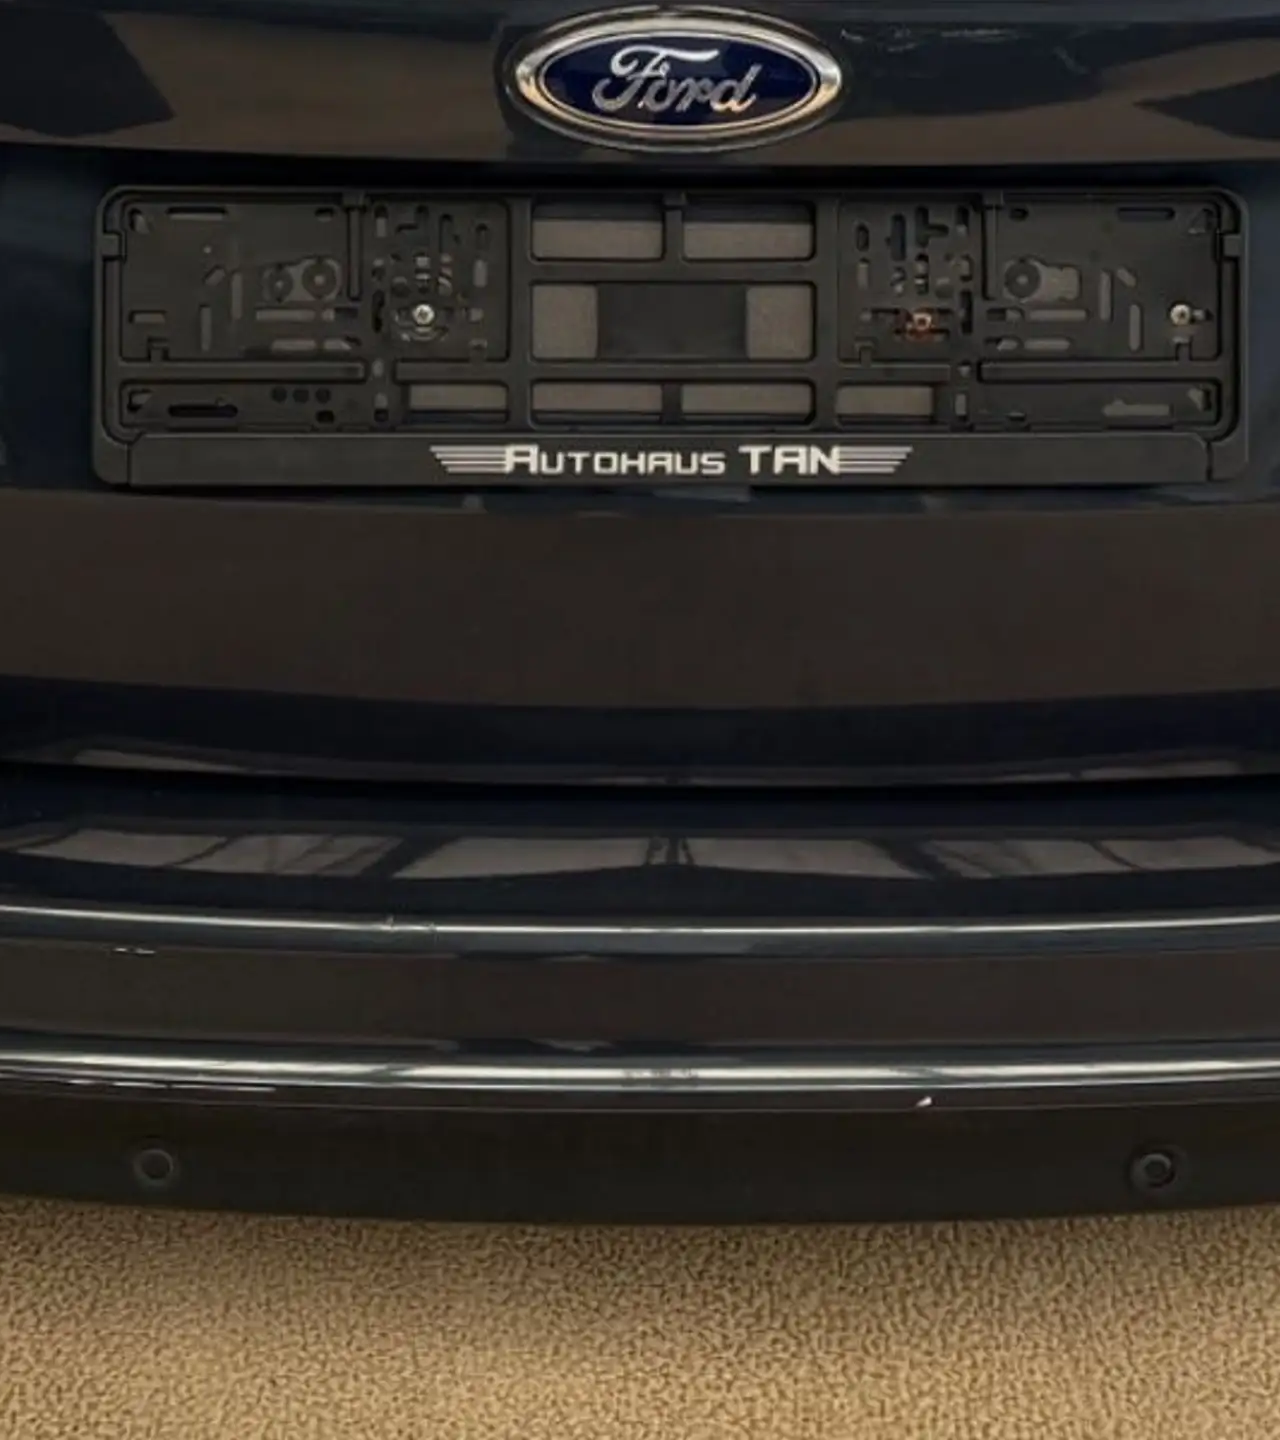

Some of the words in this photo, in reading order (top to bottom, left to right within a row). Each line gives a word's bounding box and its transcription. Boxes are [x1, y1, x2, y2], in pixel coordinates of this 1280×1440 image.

[592, 44, 762, 112] Ford
[505, 444, 725, 475] AUTOHAUS
[738, 444, 841, 475] TAN
